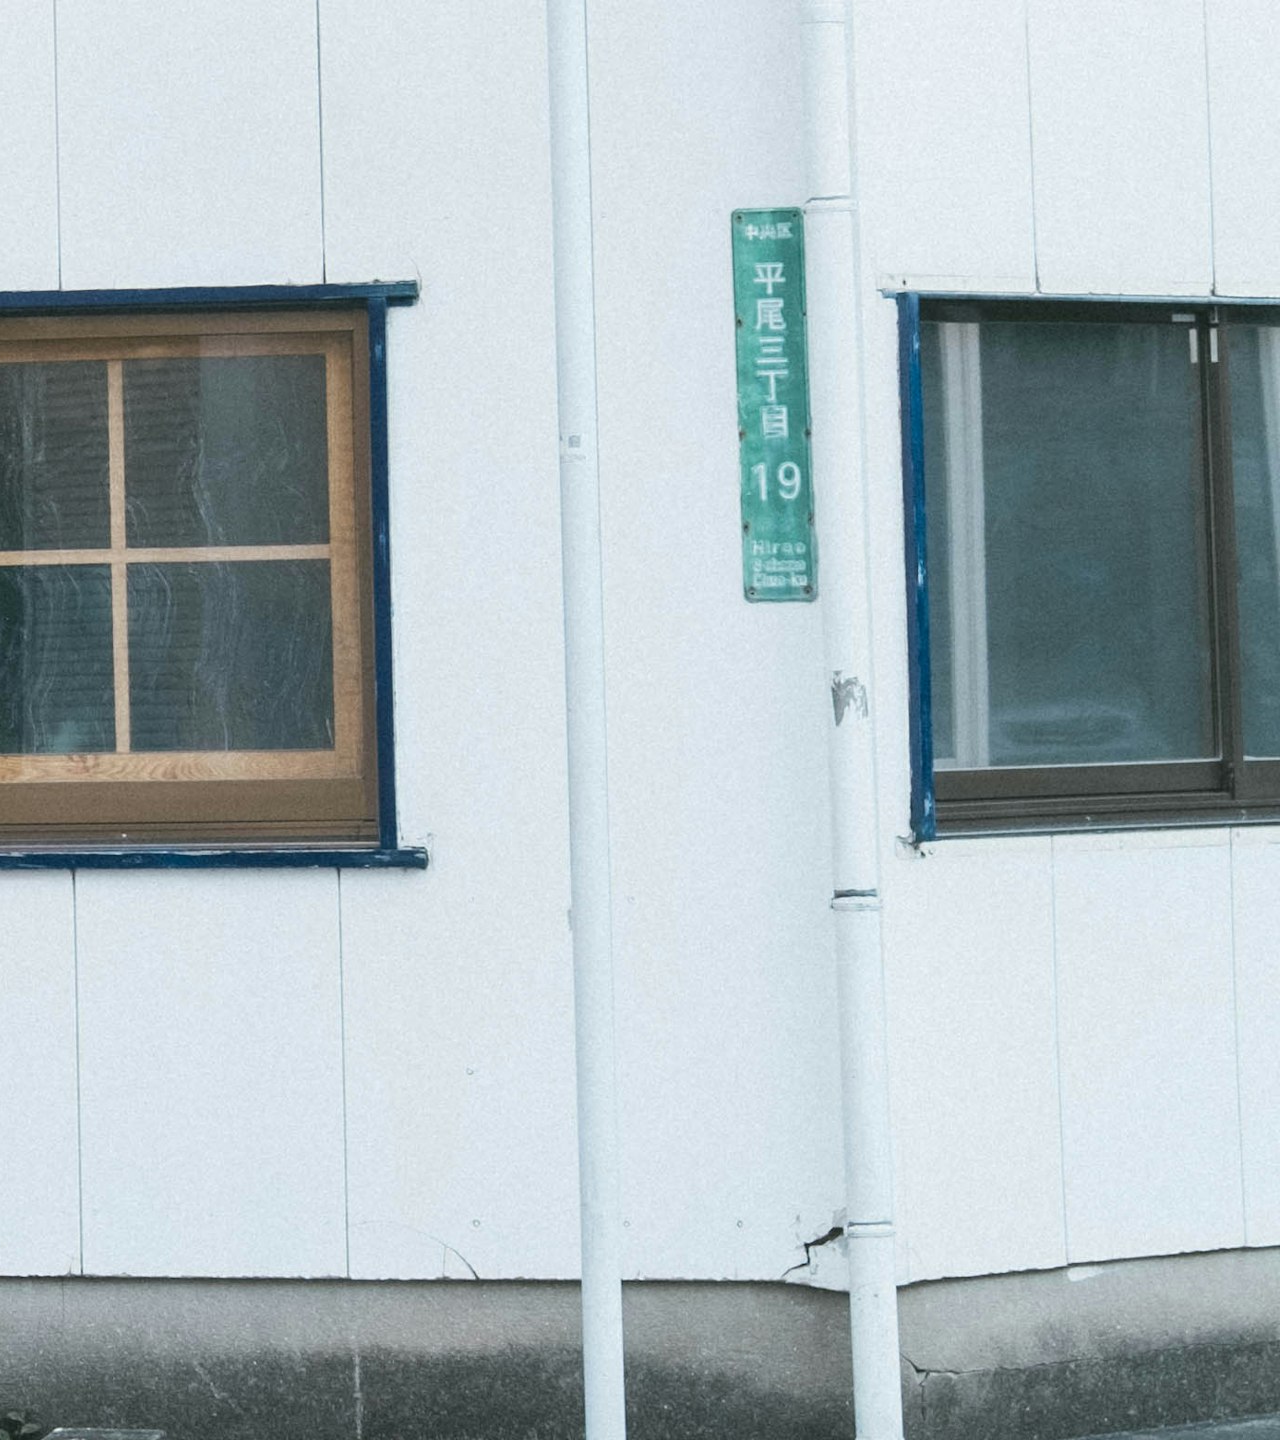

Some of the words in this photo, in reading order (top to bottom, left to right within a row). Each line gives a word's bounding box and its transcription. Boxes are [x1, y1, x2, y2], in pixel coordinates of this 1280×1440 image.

[745, 222, 793, 240] 中央区
[753, 262, 789, 438] 平尾三丁目
[751, 461, 801, 501] 19
[751, 540, 807, 556] Hirao
